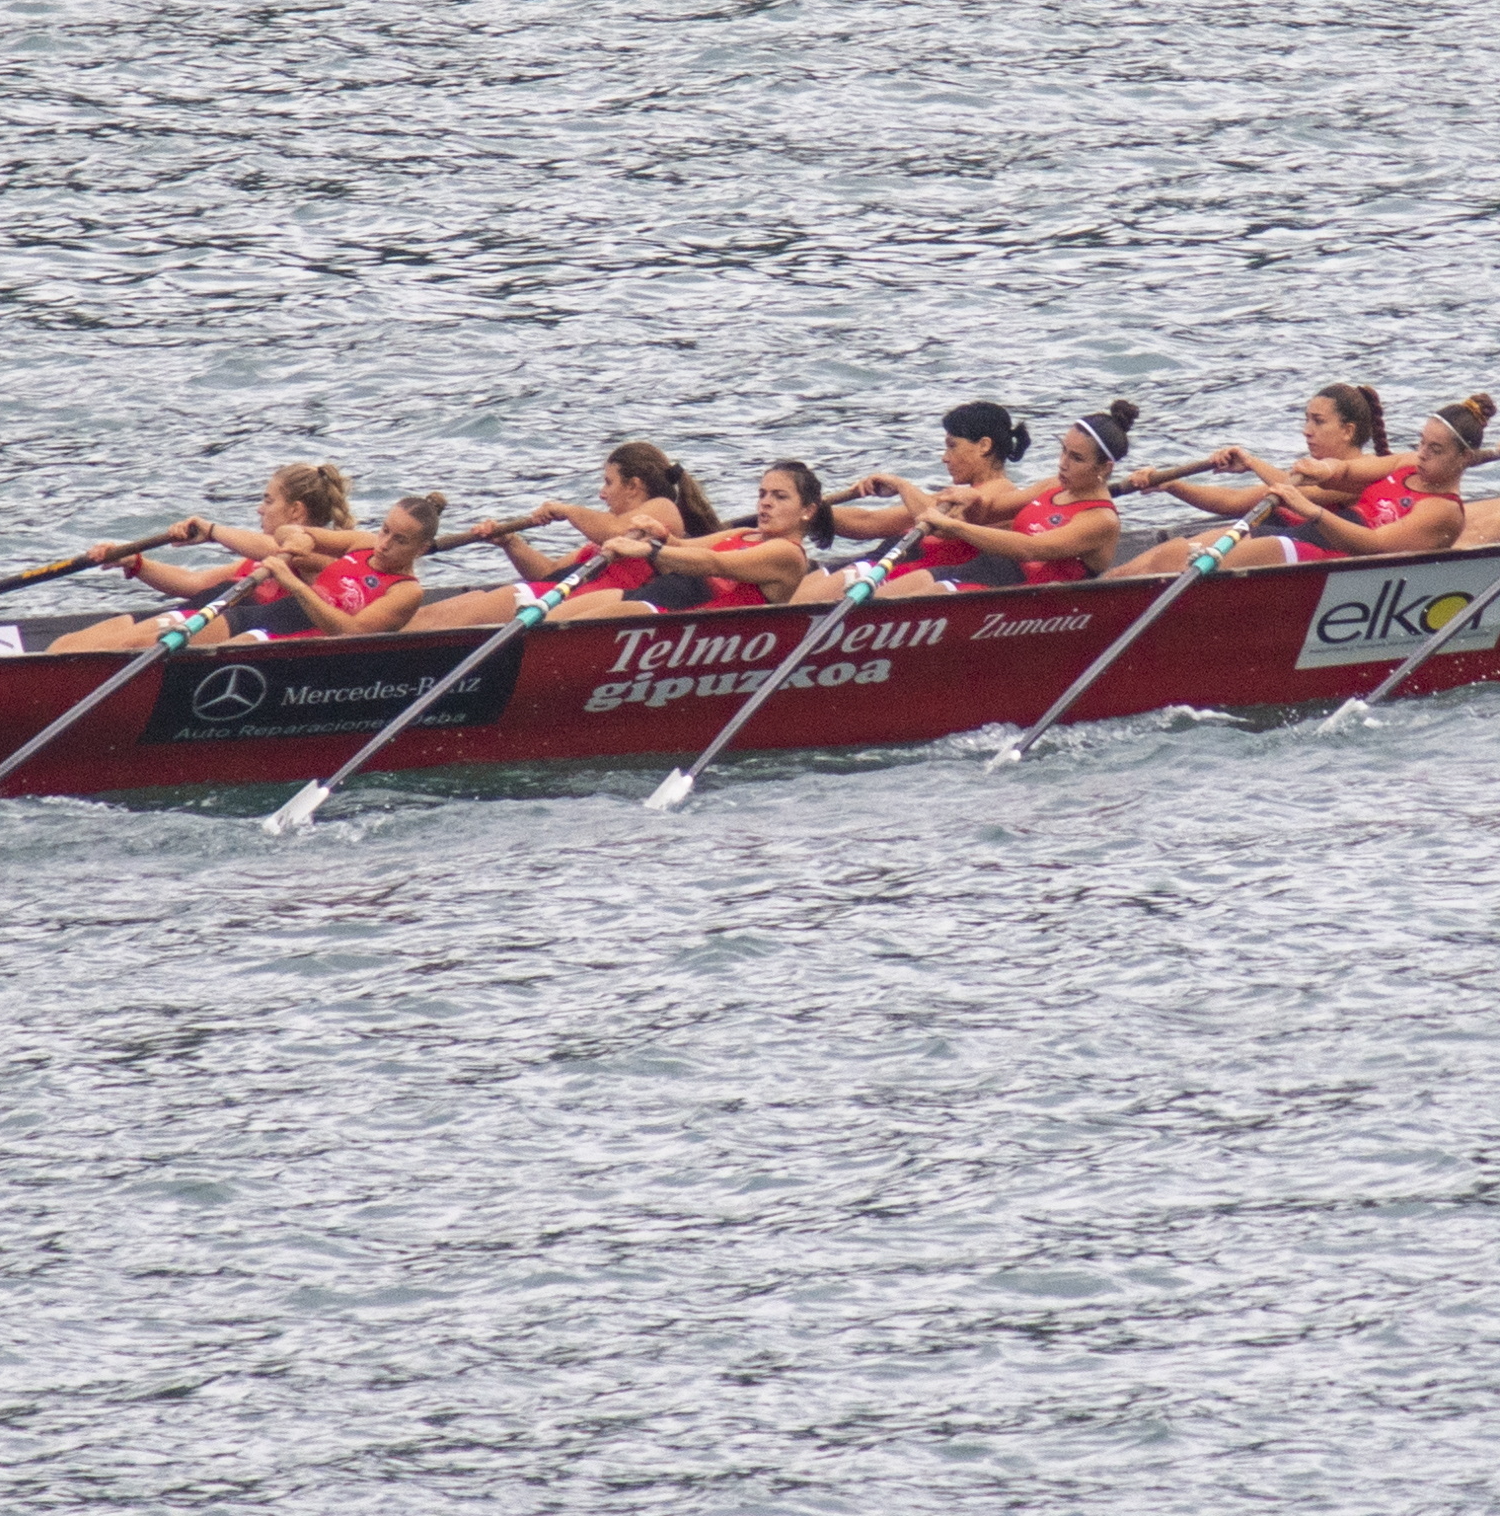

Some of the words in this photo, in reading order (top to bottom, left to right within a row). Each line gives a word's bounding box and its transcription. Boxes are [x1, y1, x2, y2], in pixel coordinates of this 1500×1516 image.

[969, 607, 1093, 640] Zumaia
[606, 624, 777, 673] Telmo
[583, 658, 892, 713] gipuzkoa
